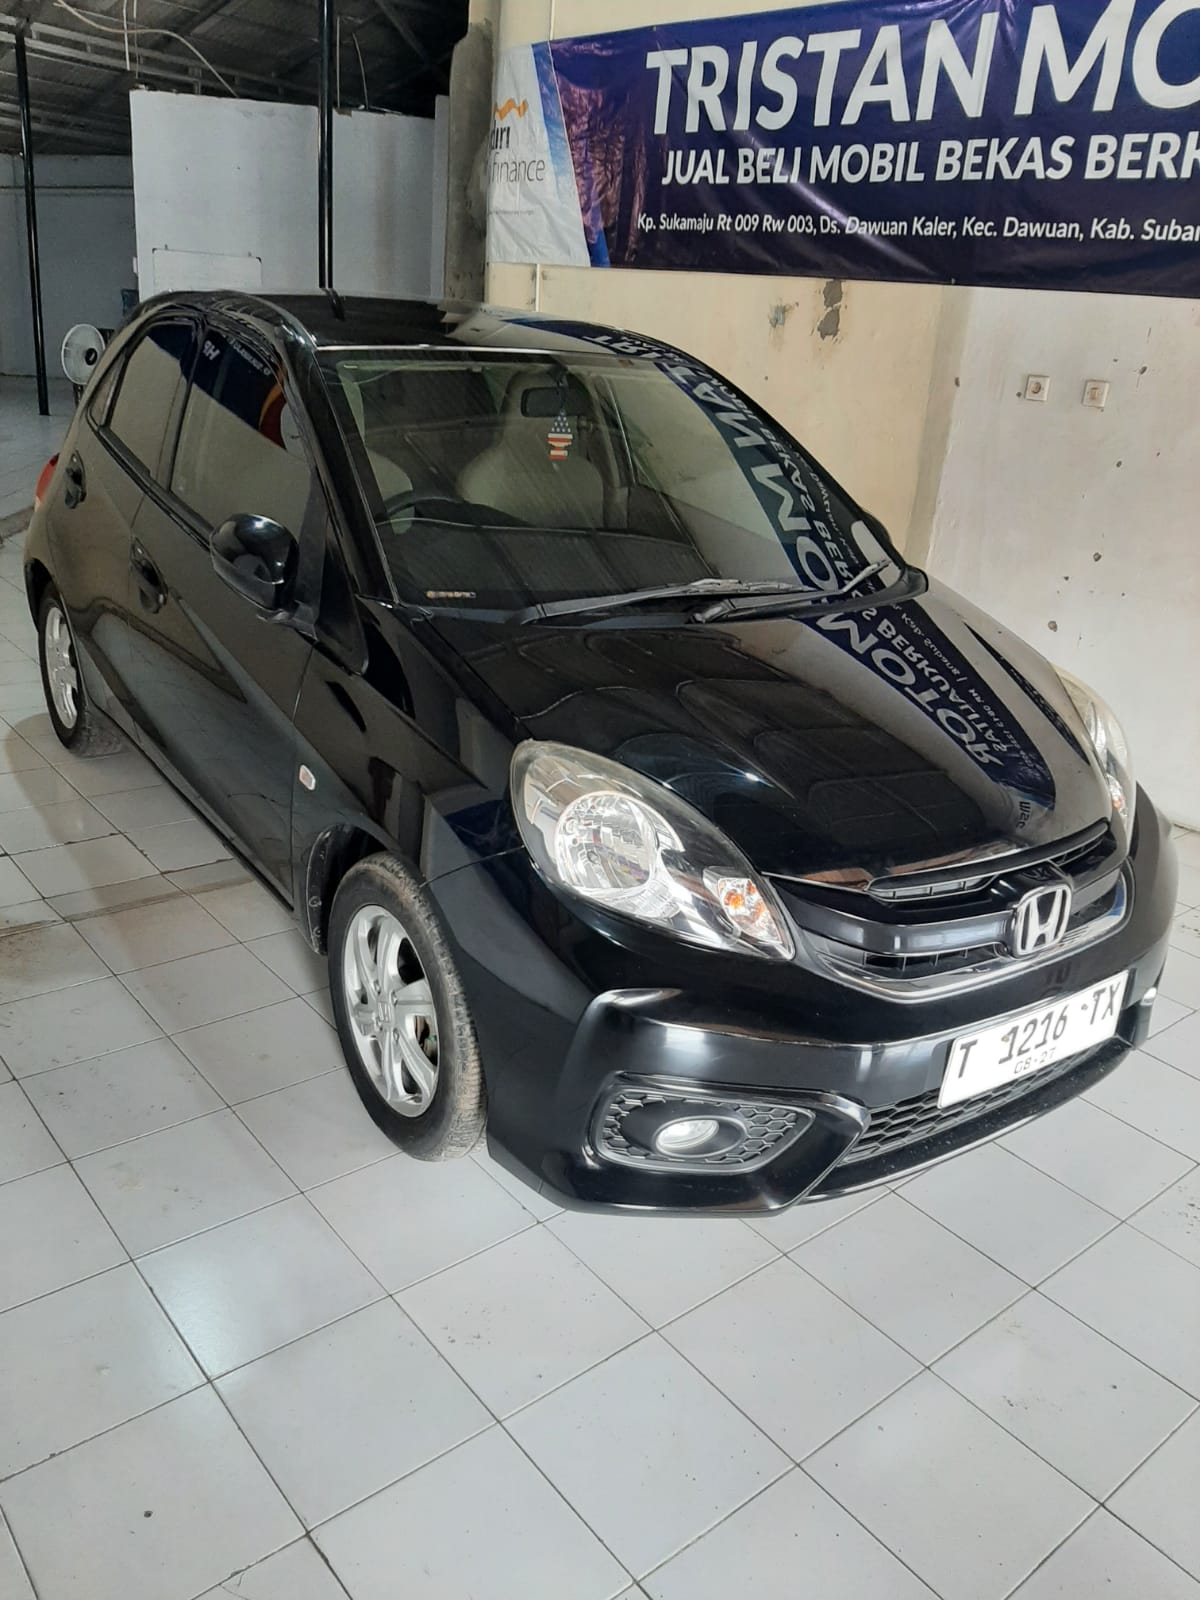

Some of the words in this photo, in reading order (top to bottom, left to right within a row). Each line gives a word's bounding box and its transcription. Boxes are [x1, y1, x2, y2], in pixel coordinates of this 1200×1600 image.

[645, 12, 999, 135] TRISTAN
[662, 149, 730, 185] JUAL
[737, 147, 801, 184] BELI
[809, 142, 925, 184] MOBIL
[935, 136, 1075, 181] BEKAS
[637, 213, 656, 233] Kp.
[659, 213, 714, 233] Sukamaju
[717, 214, 732, 231] Rt
[734, 214, 760, 232] 009
[762, 215, 785, 232] Rw
[787, 215, 817, 236] 003,
[820, 216, 841, 234] Ds.
[845, 217, 907, 235] Dawuan
[911, 216, 957, 239] Kaler,
[962, 216, 997, 237] Kec.
[1003, 217, 1084, 242] Dawuan,
[1090, 218, 1134, 240] Kab.
[958, 1039, 979, 1079] T
[998, 1005, 1068, 1065] 1216
[1089, 981, 1121, 1025] TX
